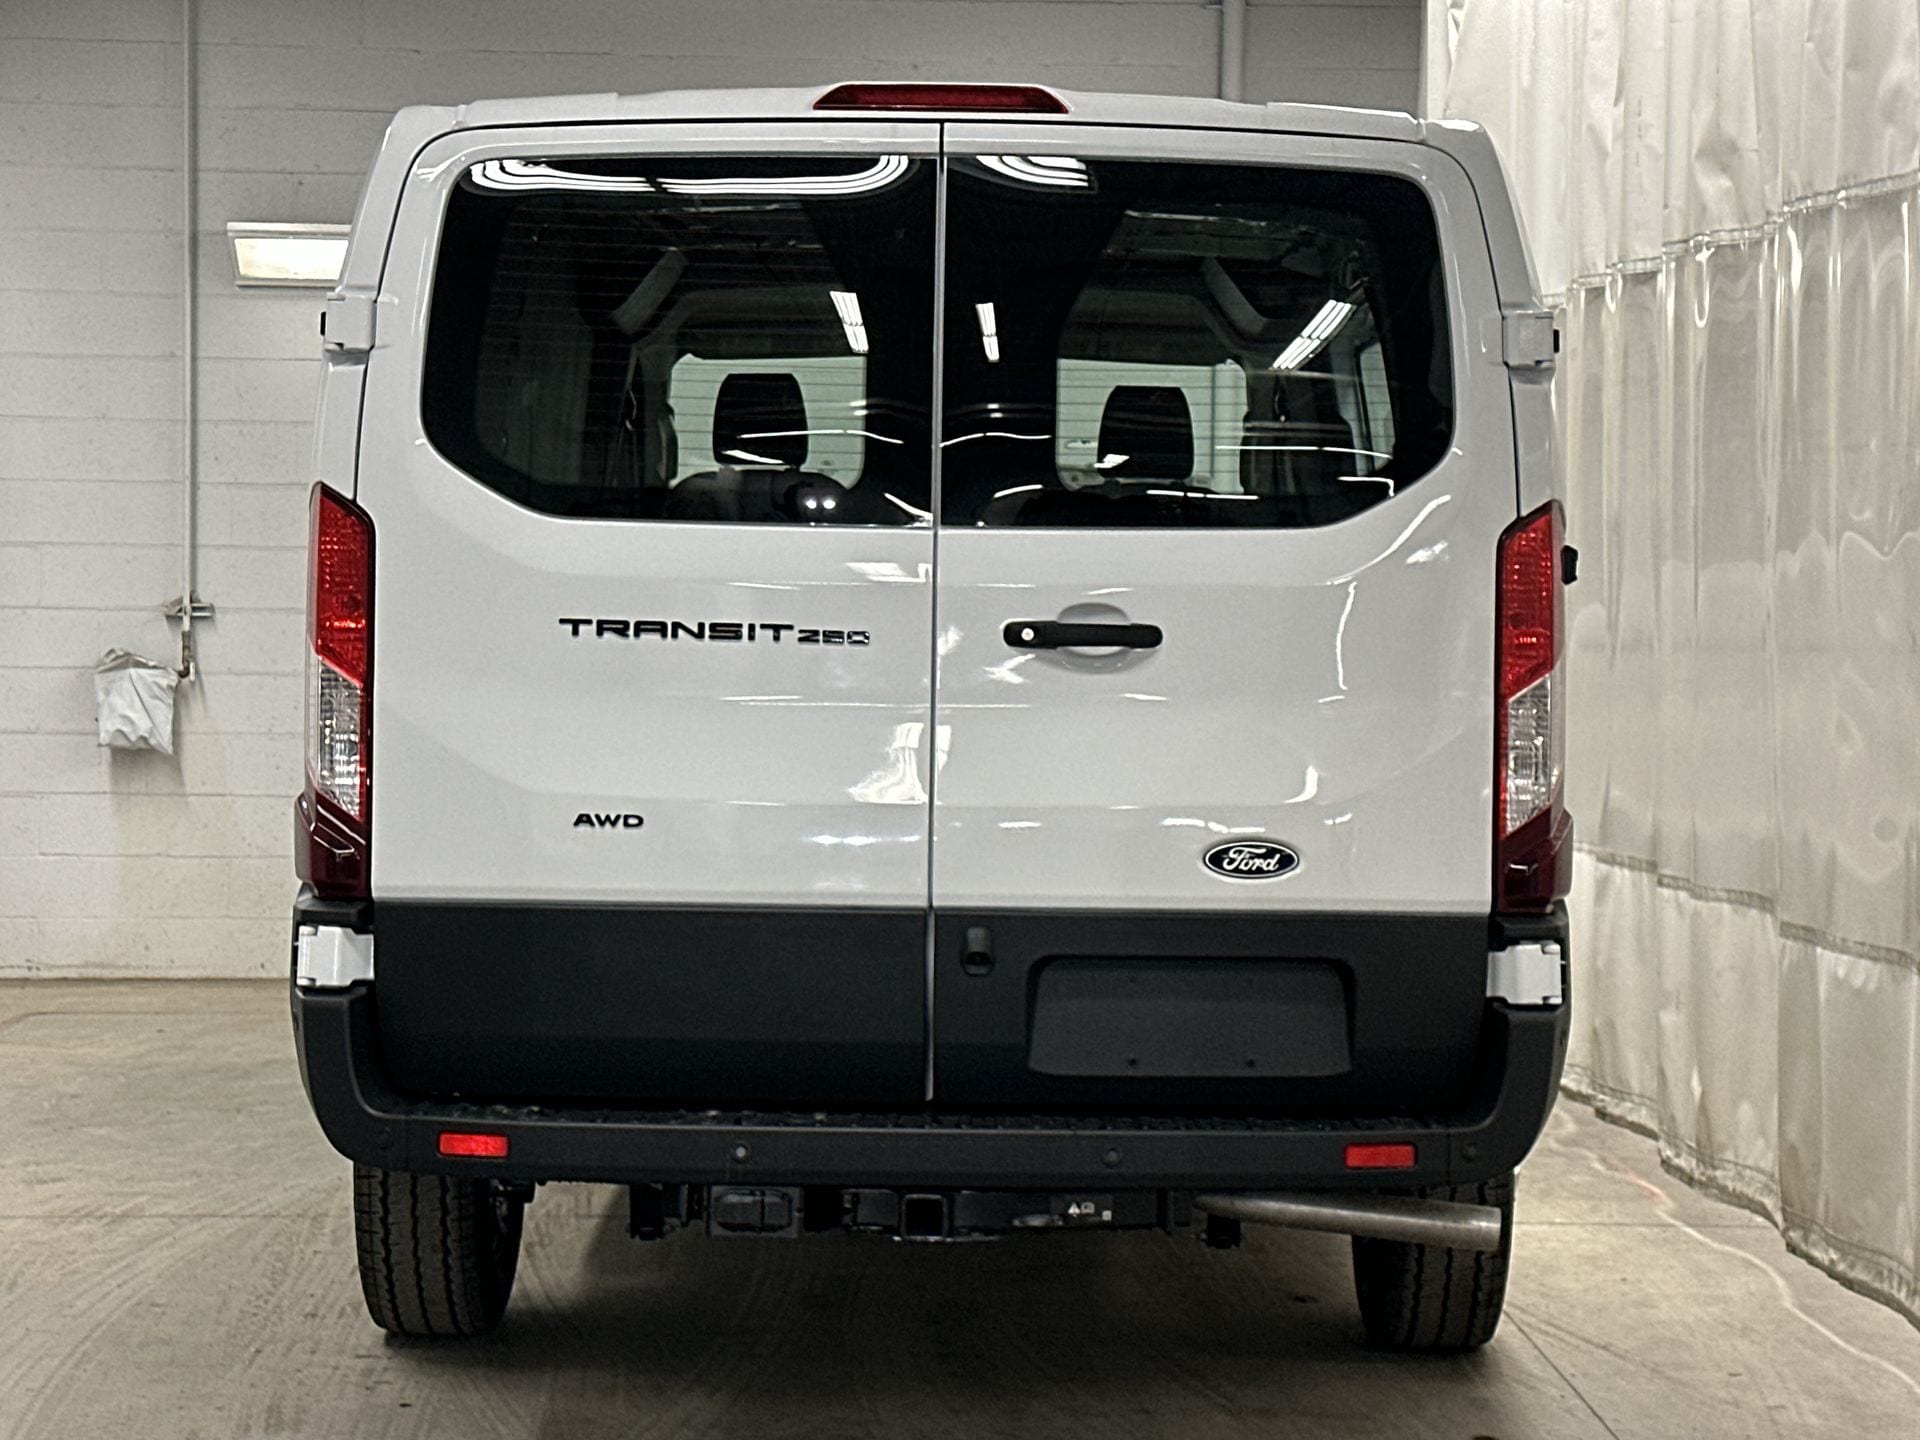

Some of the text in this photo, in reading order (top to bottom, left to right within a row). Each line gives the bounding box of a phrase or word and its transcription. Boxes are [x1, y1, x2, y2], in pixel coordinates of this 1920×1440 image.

[558, 617, 871, 646] TRANSIT 250
[572, 813, 645, 829] AWD
[1222, 846, 1281, 871] Ford
